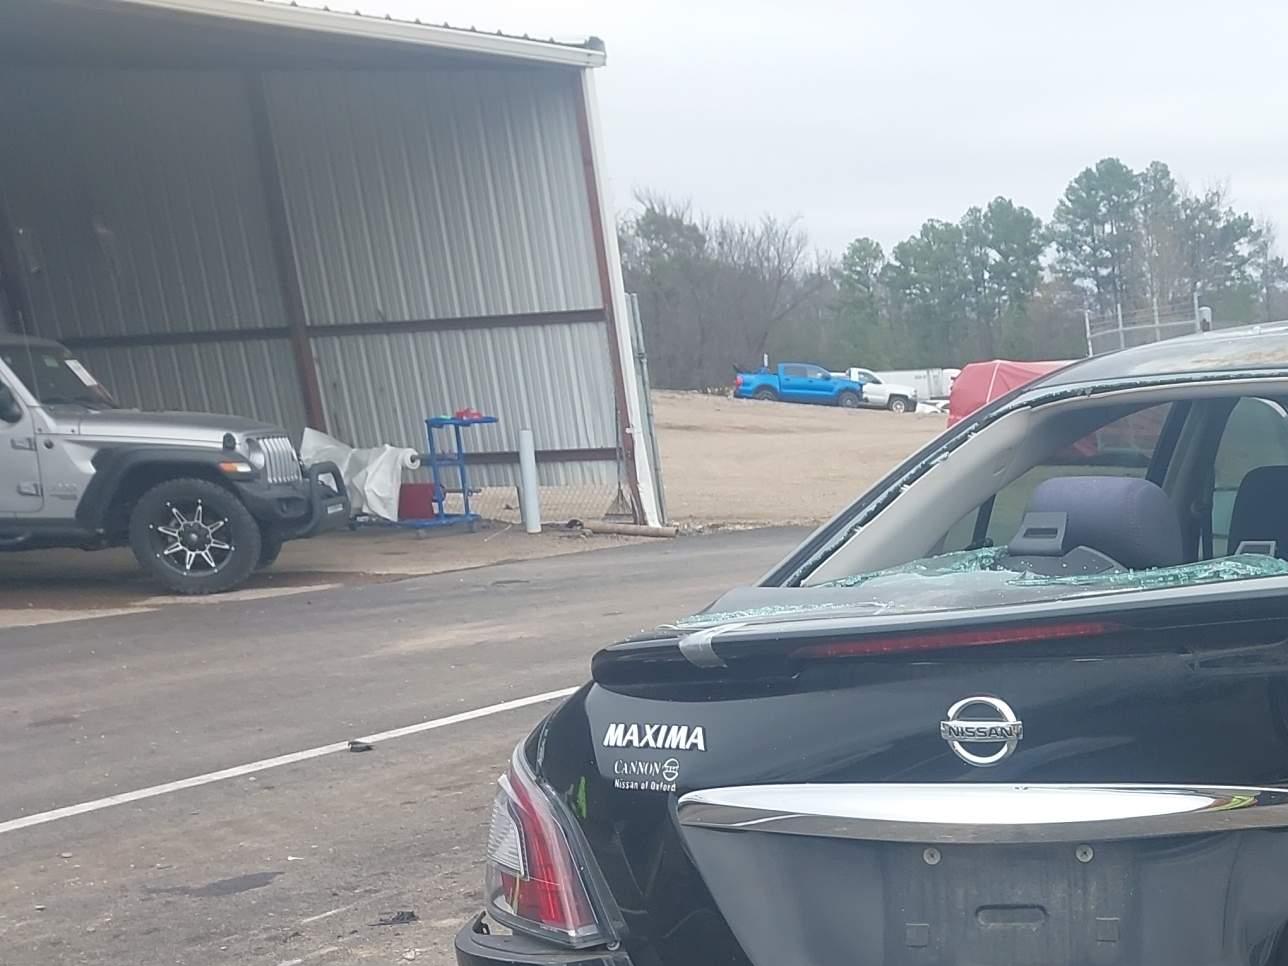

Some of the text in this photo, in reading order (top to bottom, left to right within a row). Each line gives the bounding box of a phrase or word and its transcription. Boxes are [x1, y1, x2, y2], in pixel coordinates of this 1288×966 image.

[603, 723, 706, 751] MAXIMA
[949, 726, 1013, 738] NISSAN
[614, 759, 662, 776] CANNON
[614, 778, 677, 792] Nissan of Oxford
